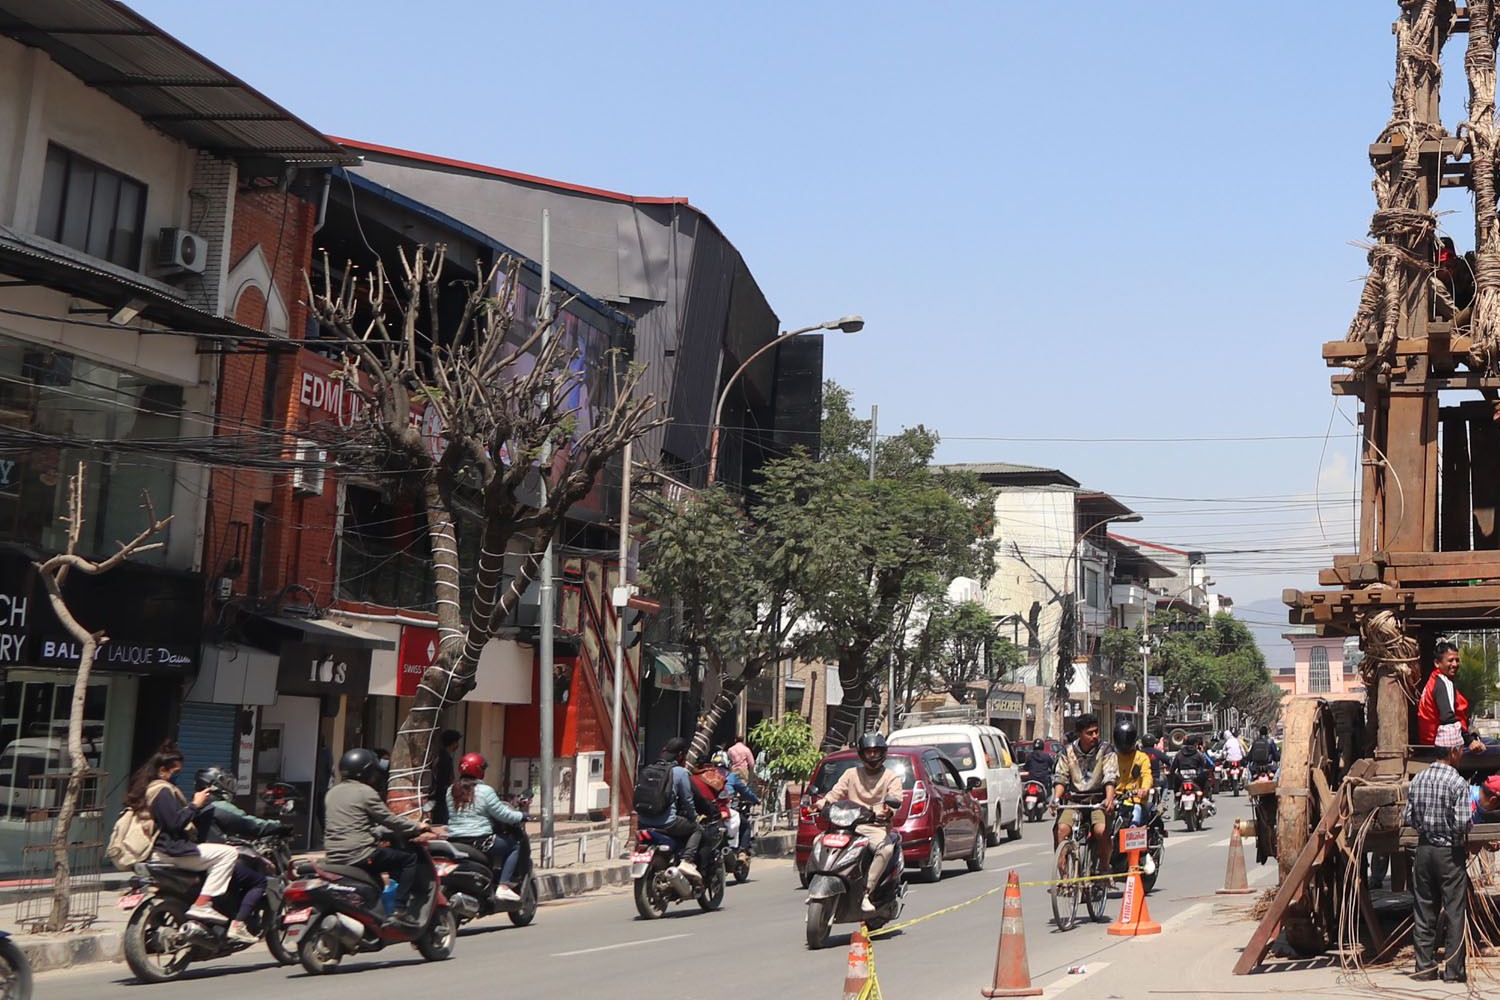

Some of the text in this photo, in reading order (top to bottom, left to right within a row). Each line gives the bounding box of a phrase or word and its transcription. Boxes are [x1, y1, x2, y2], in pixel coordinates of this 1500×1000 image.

[43, 641, 103, 659] BALY
[108, 645, 154, 665] LALIQUE
[403, 664, 421, 674] SWISS
